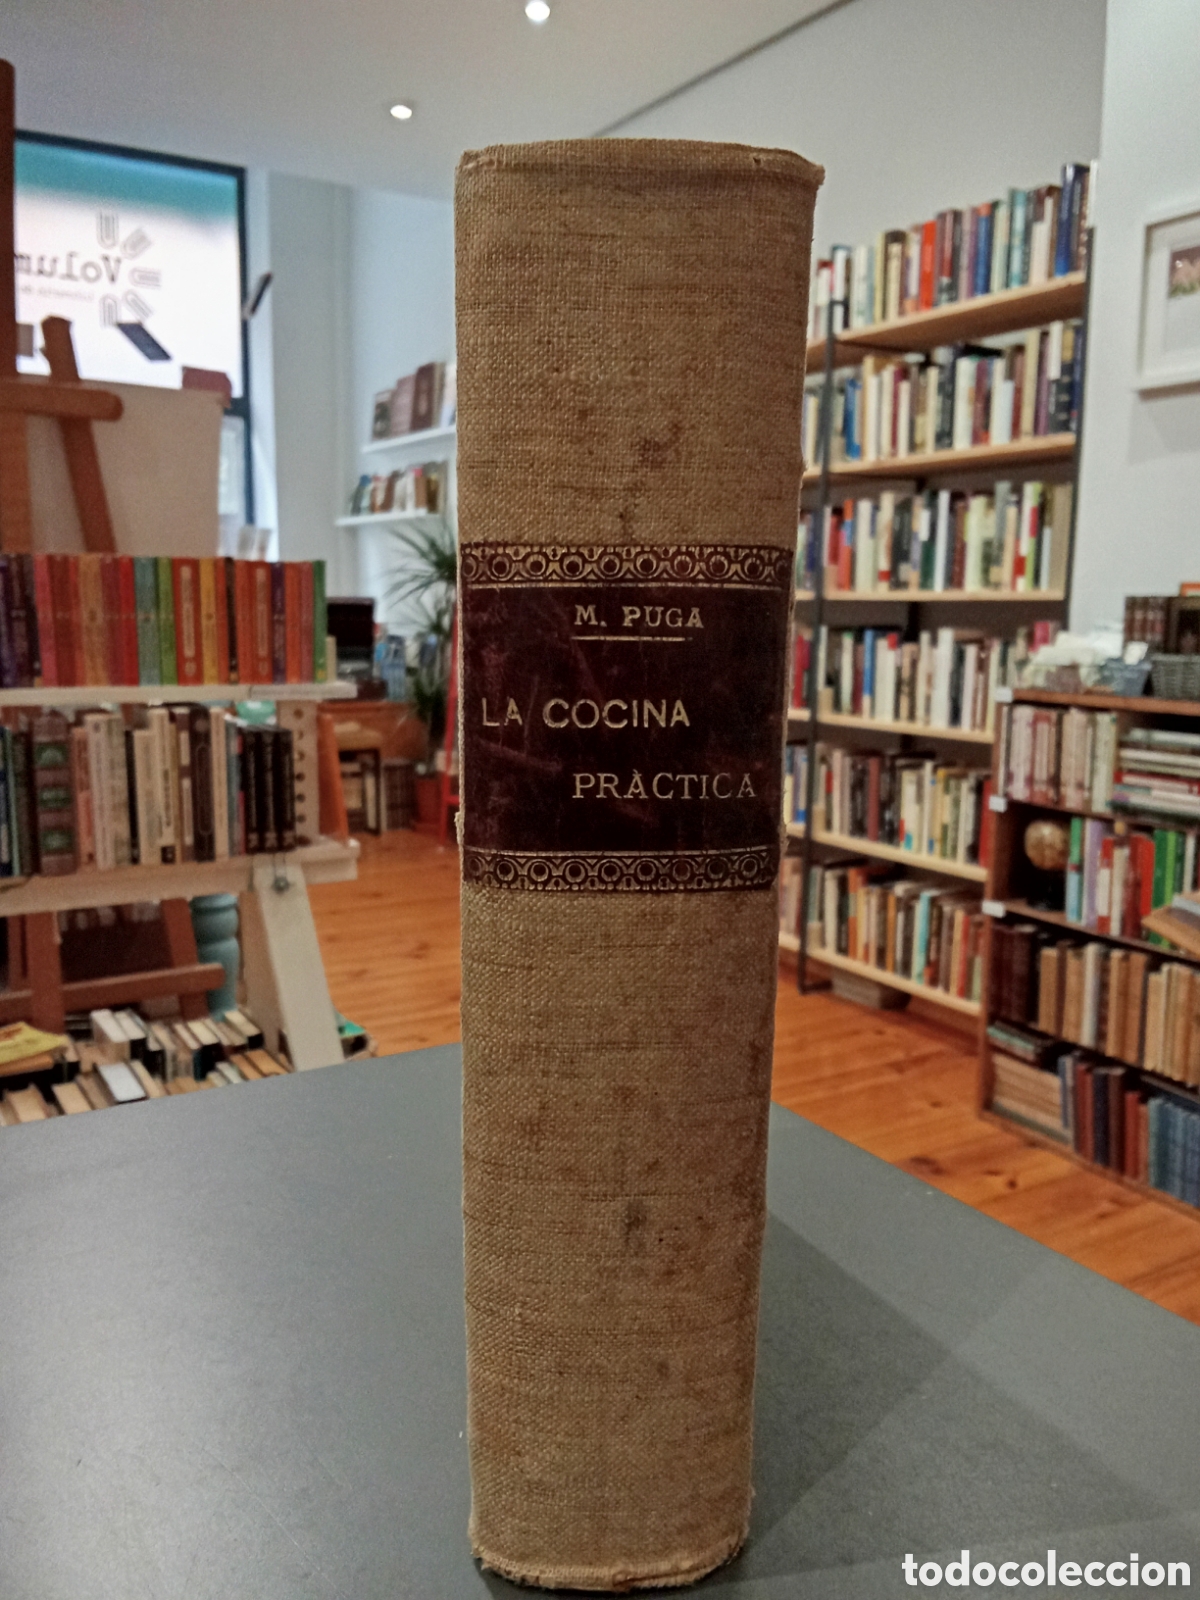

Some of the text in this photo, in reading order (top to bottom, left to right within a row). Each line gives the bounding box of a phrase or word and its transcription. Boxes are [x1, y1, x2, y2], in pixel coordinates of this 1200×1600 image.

[574, 605, 704, 628] M. PUGA
[481, 697, 691, 729] LA COCINA
